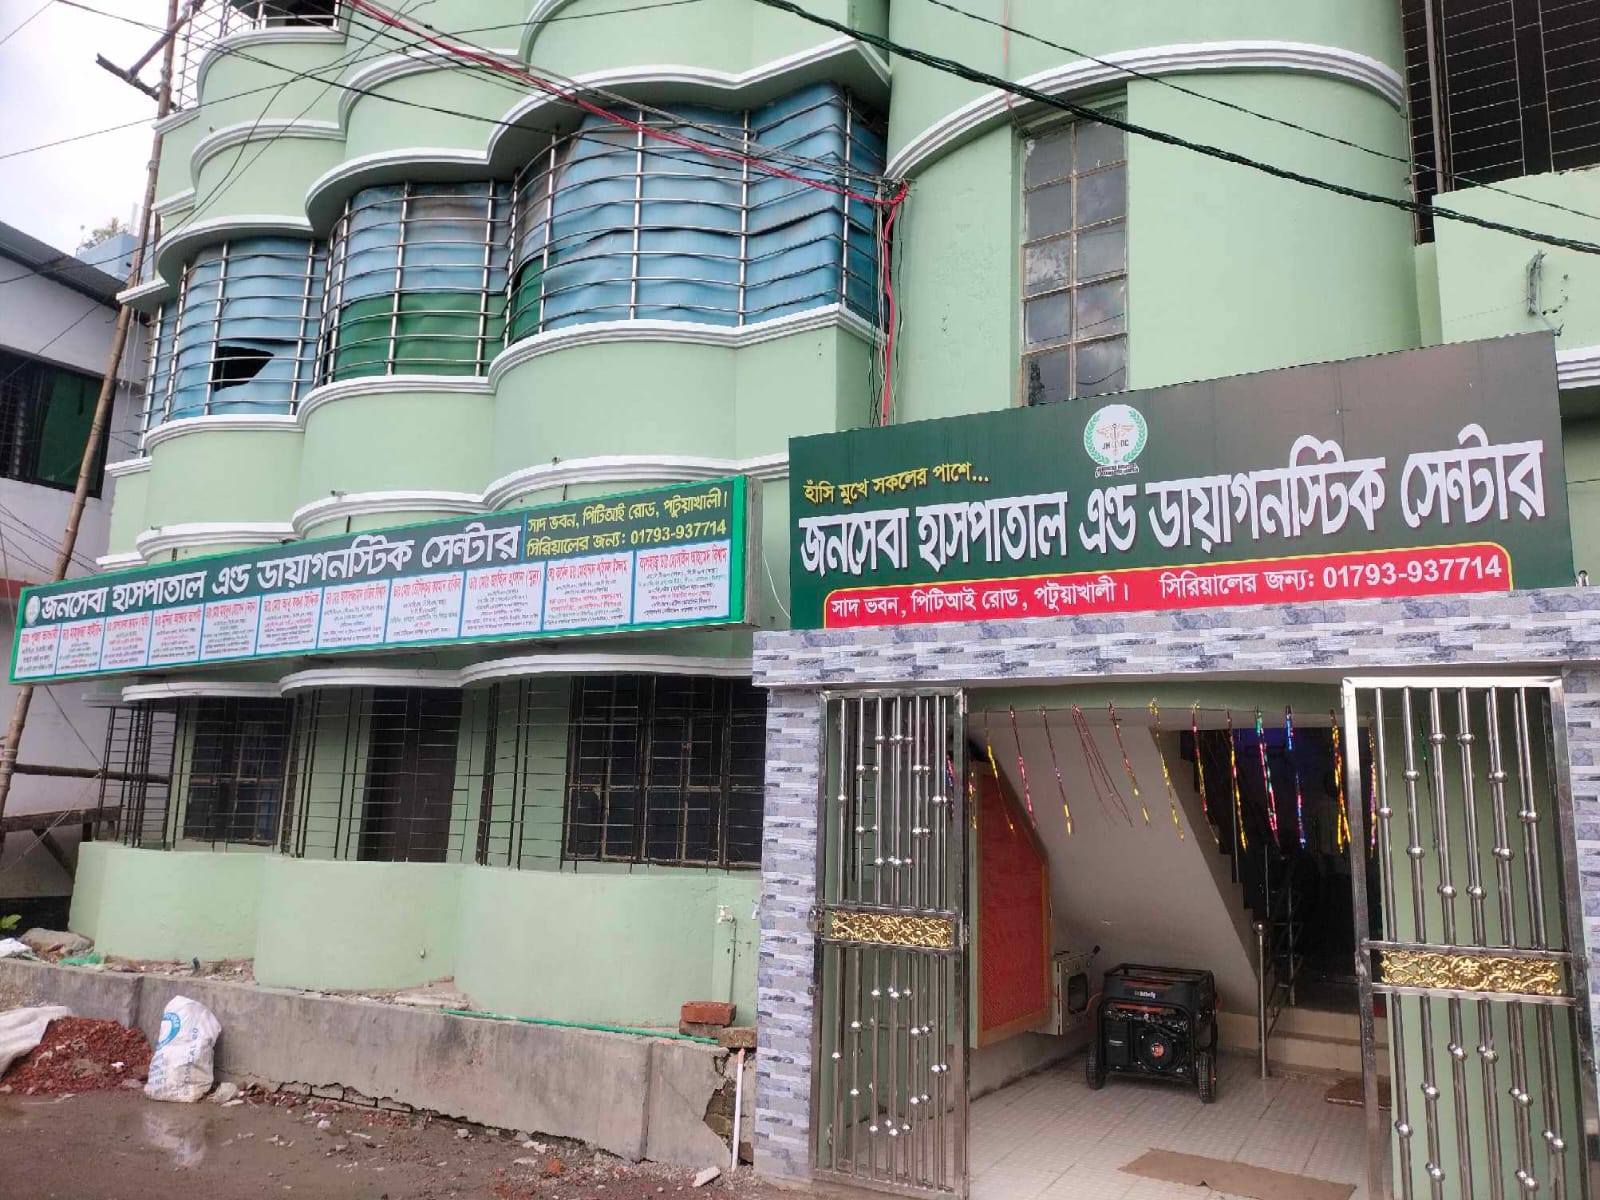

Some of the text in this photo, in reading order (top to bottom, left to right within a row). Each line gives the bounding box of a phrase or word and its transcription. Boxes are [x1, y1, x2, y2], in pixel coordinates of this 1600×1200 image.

[799, 507, 910, 577] জনসেবা
[916, 491, 1068, 572] হাসপাতাল
[1145, 434, 1386, 553] ডায়াগনস্টিক
[1401, 423, 1546, 528] সেন্টার
[803, 479, 835, 504] হাঁসি
[838, 478, 869, 505] মুখে
[872, 467, 928, 494] সকলের
[526, 535, 590, 557] সিরিয়ালের
[630, 519, 727, 545] 01793-937714
[527, 516, 547, 533] সাদ
[582, 503, 626, 527] পিটিআই
[41, 586, 109, 622] জনসেবা
[112, 570, 207, 613] হাসপাতাল
[257, 534, 415, 590] ডায়াগনস্টিক
[421, 522, 522, 569] সেন্টার
[831, 599, 859, 618] সাদ
[910, 586, 977, 613] পিটিআই
[1160, 571, 1258, 599] সিরিয়ালের
[1323, 554, 1503, 589] 01793-937714
